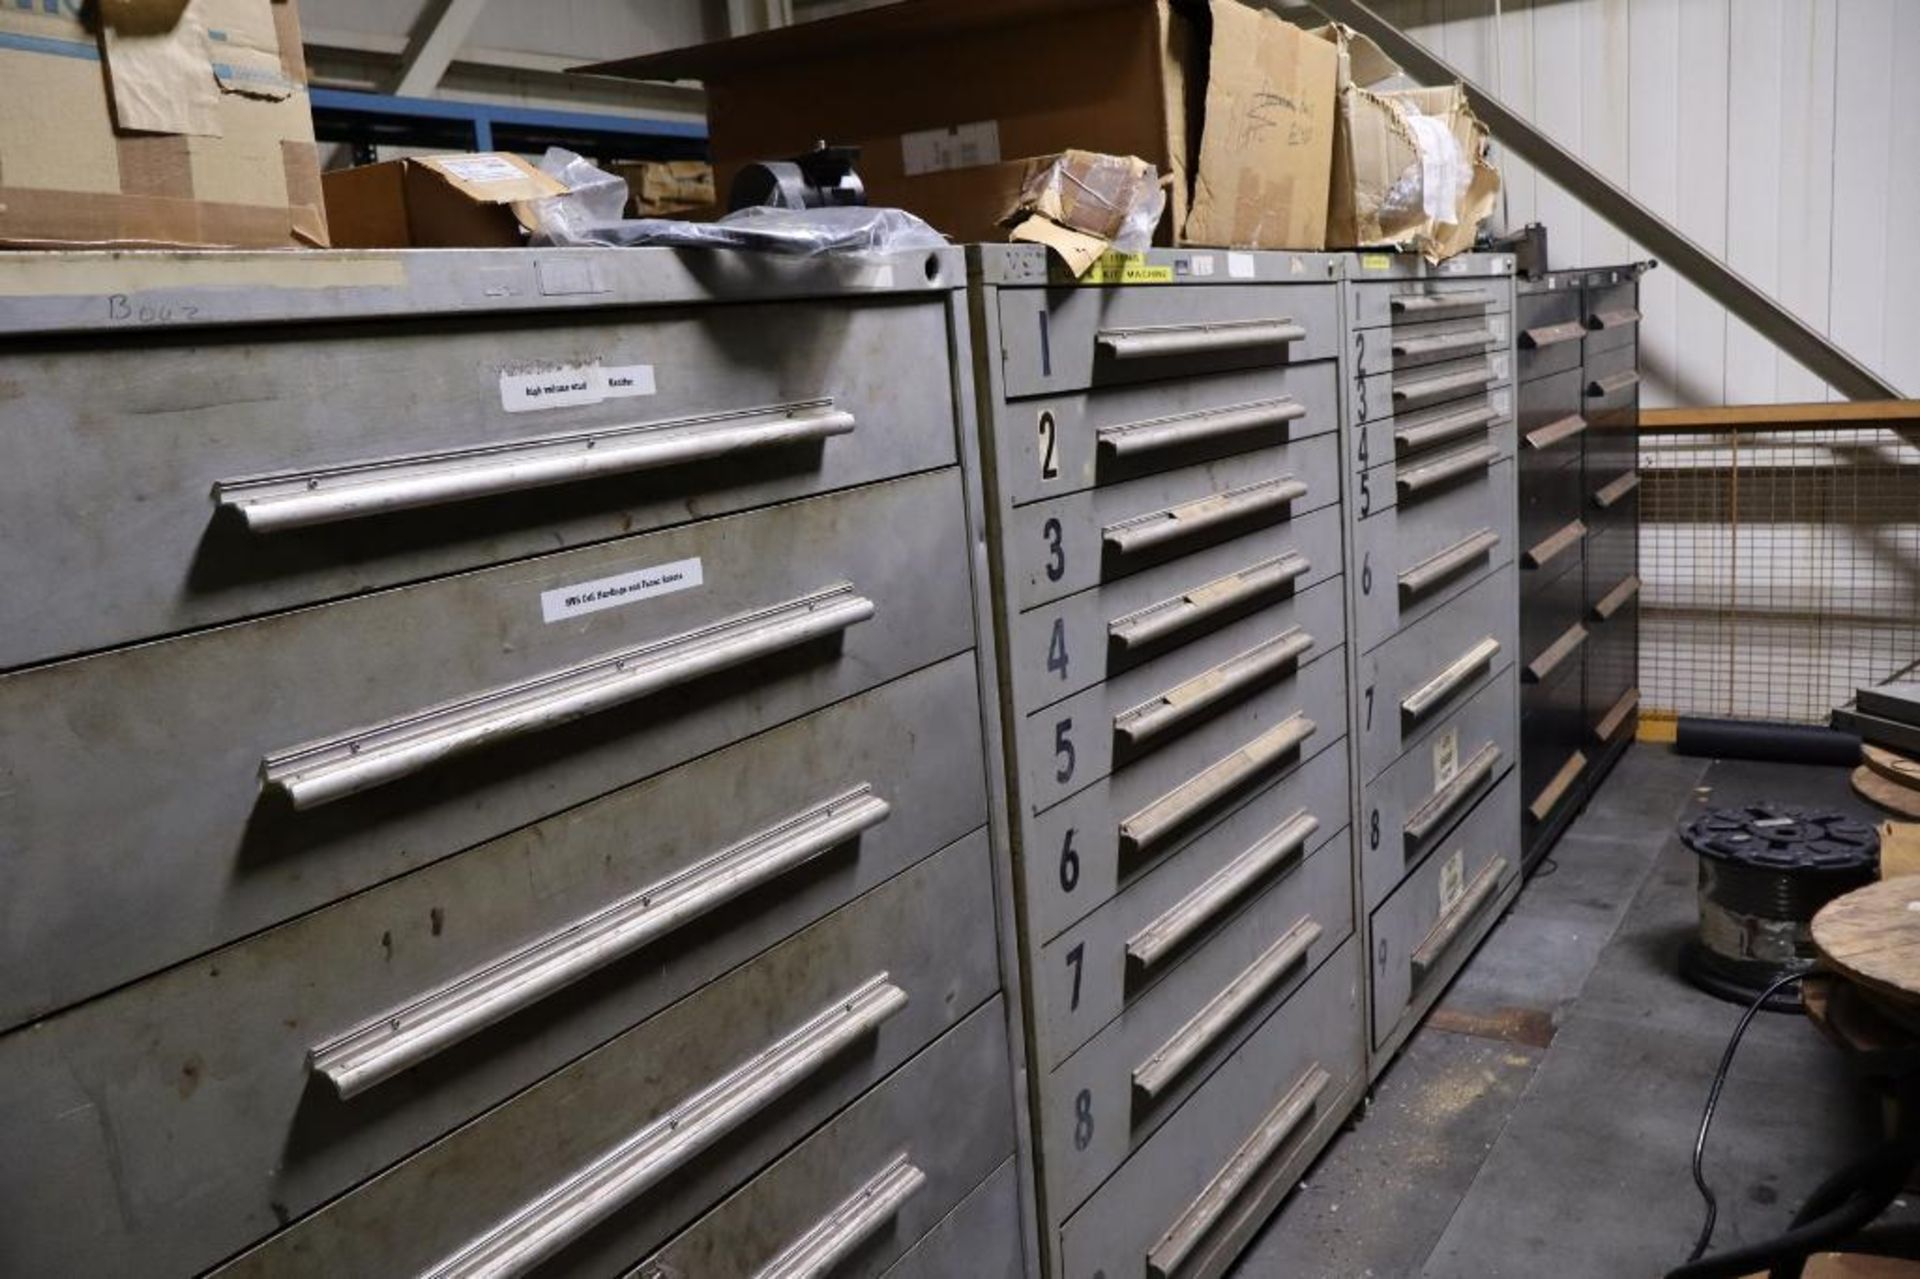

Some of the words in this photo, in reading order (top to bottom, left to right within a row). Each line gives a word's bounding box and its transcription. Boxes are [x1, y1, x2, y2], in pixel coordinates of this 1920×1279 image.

[1126, 269, 1168, 280] MACHINE
[1355, 332, 1366, 377] 2
[1356, 379, 1367, 424] 3
[1038, 410, 1058, 480] 2
[1358, 426, 1368, 470] 4
[1360, 475, 1371, 520] 5
[1043, 517, 1065, 583] 3
[1361, 551, 1372, 596] 6
[1046, 617, 1069, 681] 4
[1364, 686, 1374, 732] 7
[1055, 717, 1076, 784] 5
[1370, 808, 1380, 851] 8
[1059, 828, 1080, 894] 6
[1065, 941, 1085, 1013] 7
[1378, 939, 1388, 976] 9
[1074, 1088, 1095, 1152] 8
